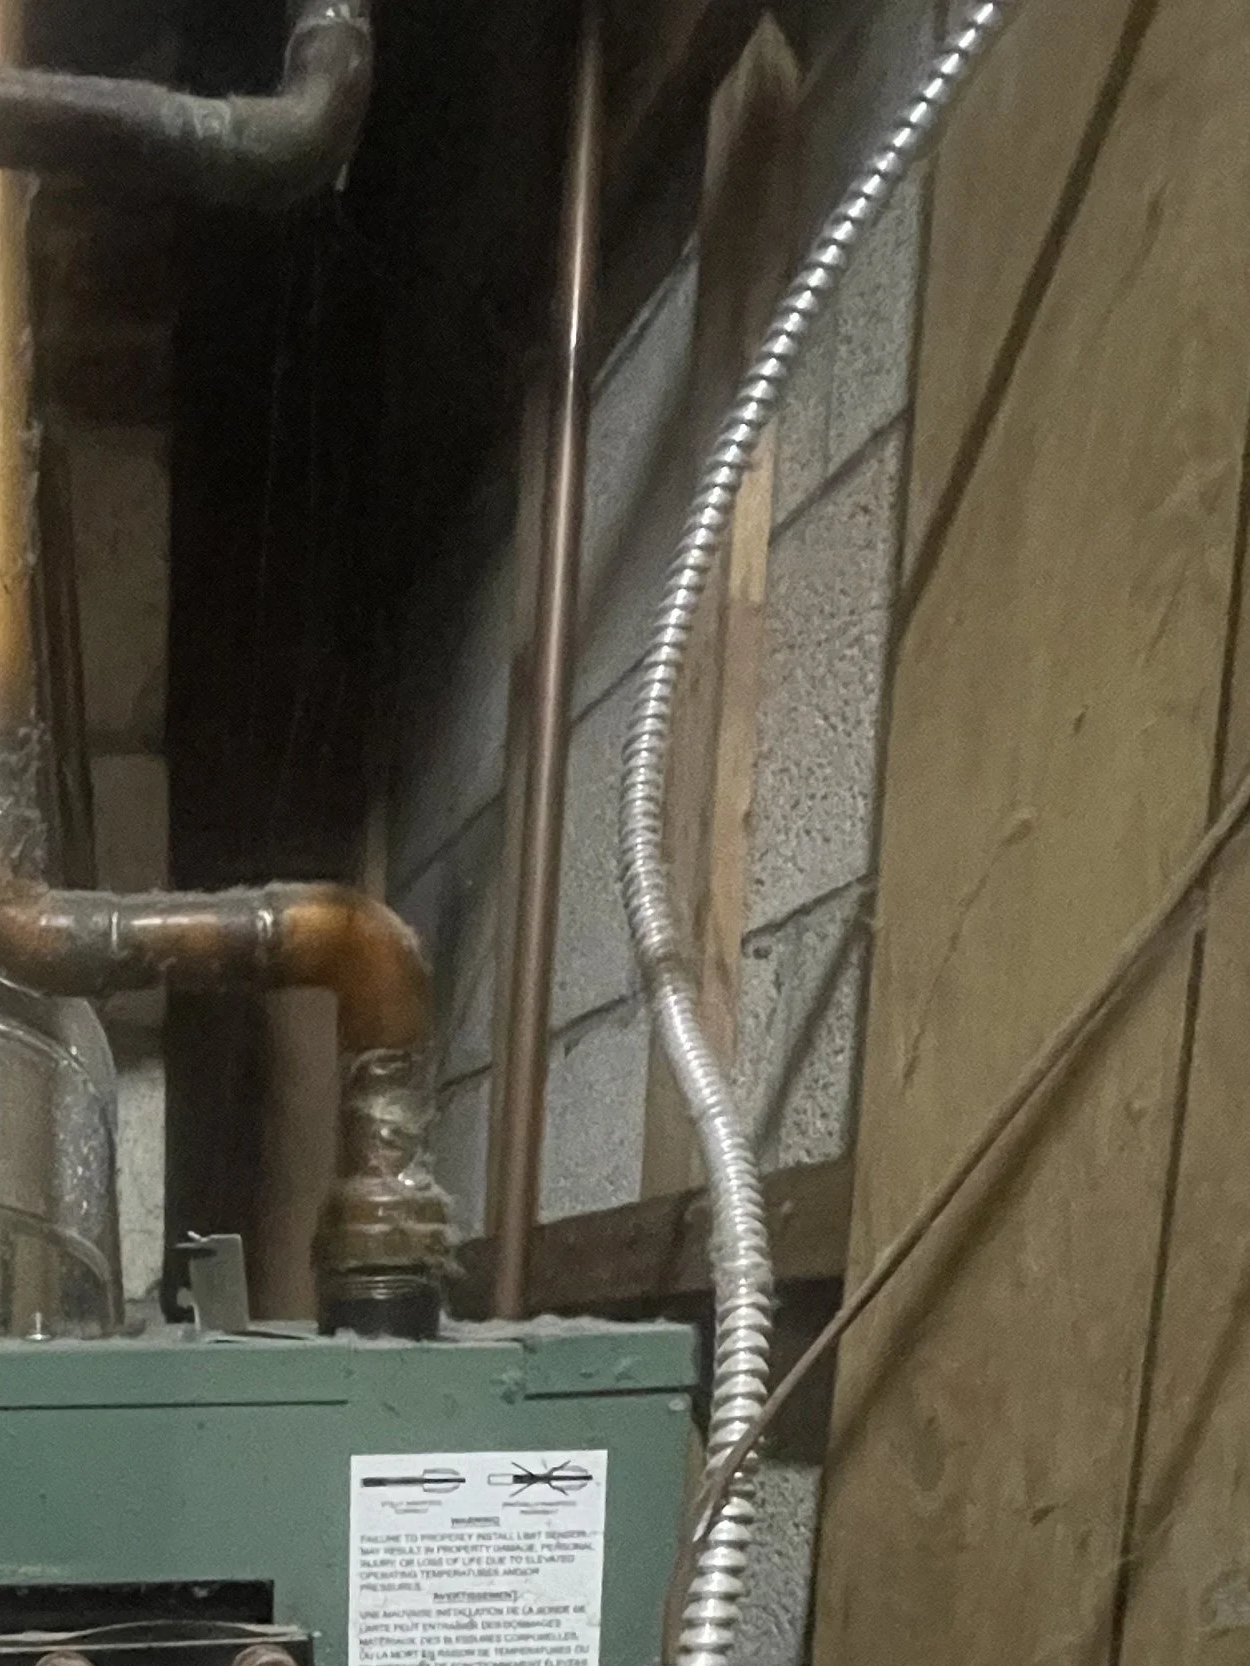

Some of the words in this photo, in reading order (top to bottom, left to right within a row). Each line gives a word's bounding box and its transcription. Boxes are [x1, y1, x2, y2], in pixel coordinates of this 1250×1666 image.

[405, 1534, 418, 1543] TO
[446, 1557, 459, 1566] OF
[462, 1556, 484, 1566] LIFE
[486, 1556, 506, 1565] DUE
[510, 1555, 523, 1564] TO
